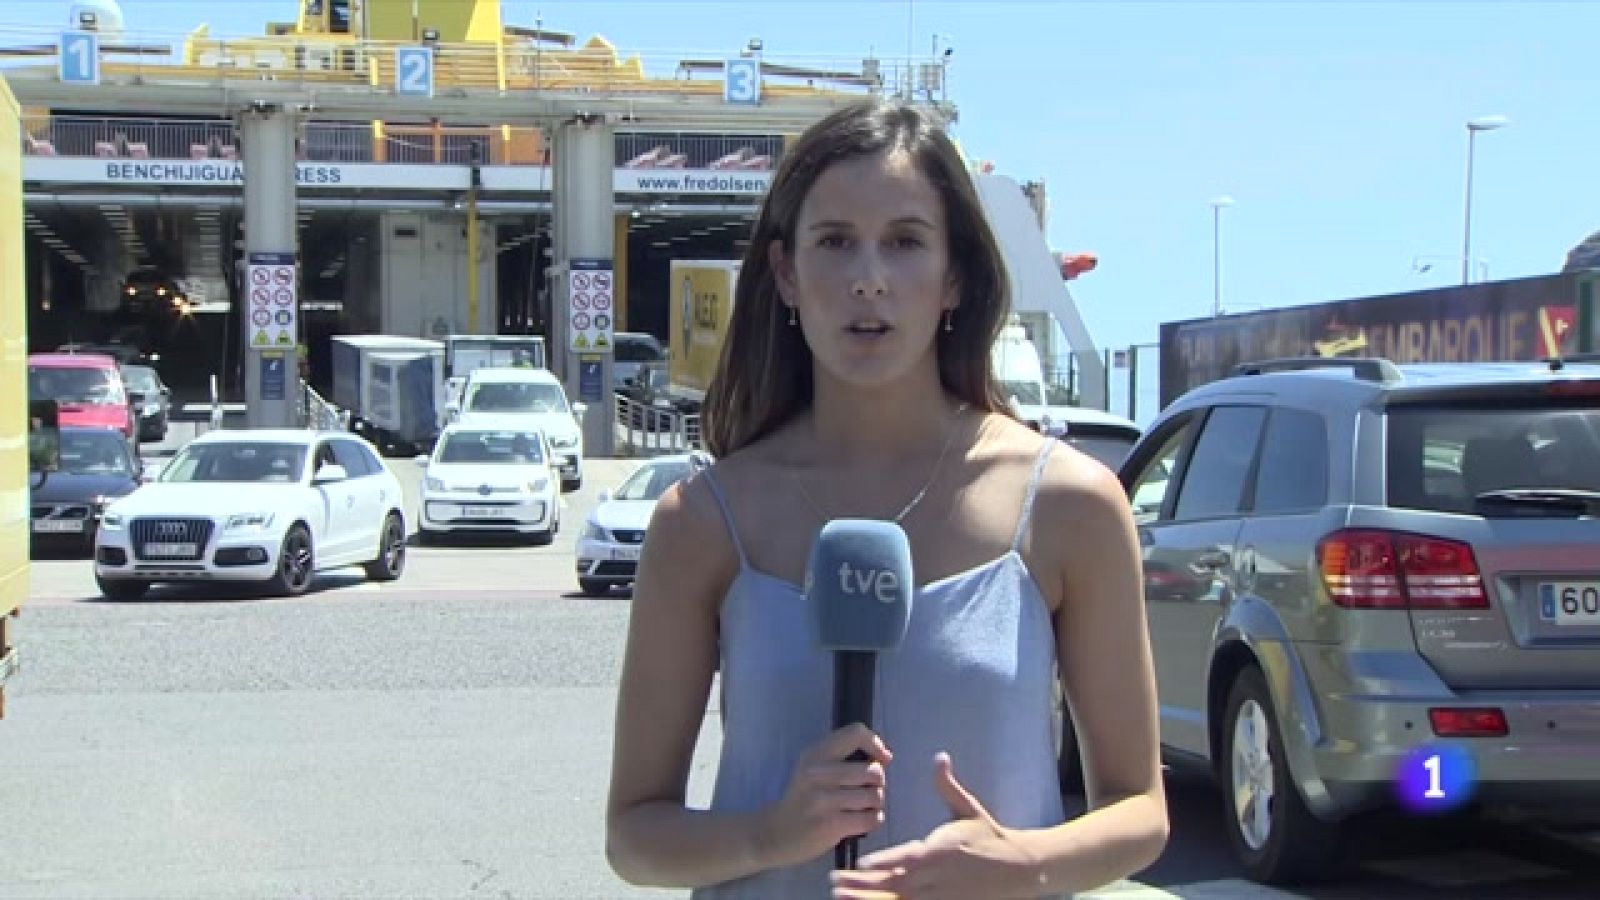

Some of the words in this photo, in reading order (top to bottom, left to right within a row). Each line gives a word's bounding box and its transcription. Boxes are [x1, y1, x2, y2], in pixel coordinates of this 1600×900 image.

[69, 39, 89, 77] 1
[404, 54, 426, 91] 2
[731, 64, 753, 100] 3
[107, 163, 244, 181] BENCHIJIGUA
[838, 561, 896, 603] tve
[1561, 587, 1599, 615] 60
